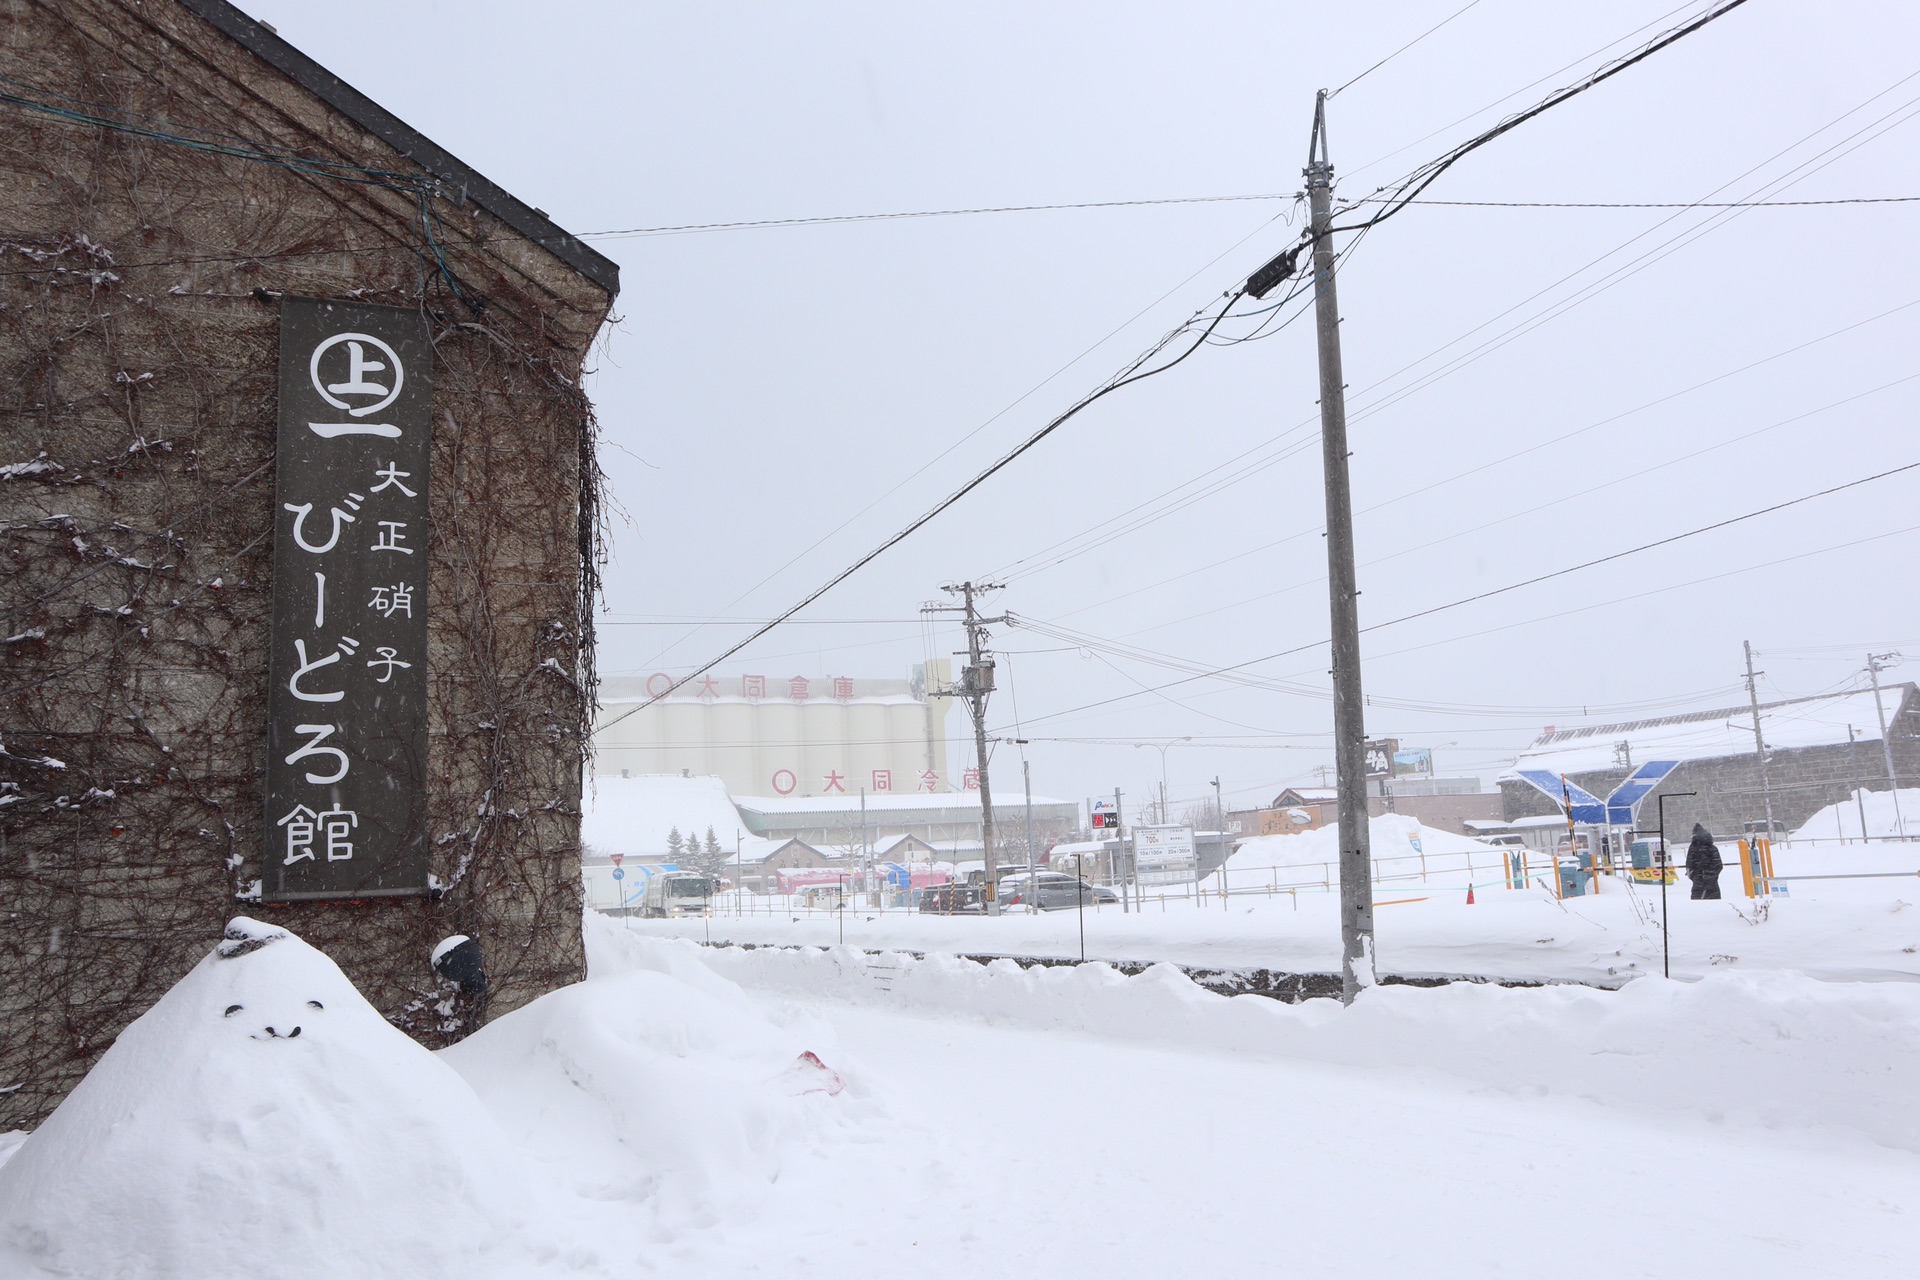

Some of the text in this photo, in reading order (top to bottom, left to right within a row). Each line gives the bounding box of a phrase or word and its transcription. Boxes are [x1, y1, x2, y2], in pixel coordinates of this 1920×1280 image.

[276, 492, 365, 867] びーどろ館
[366, 460, 417, 684] 大正硝子
[696, 673, 855, 700] 大同倉庫
